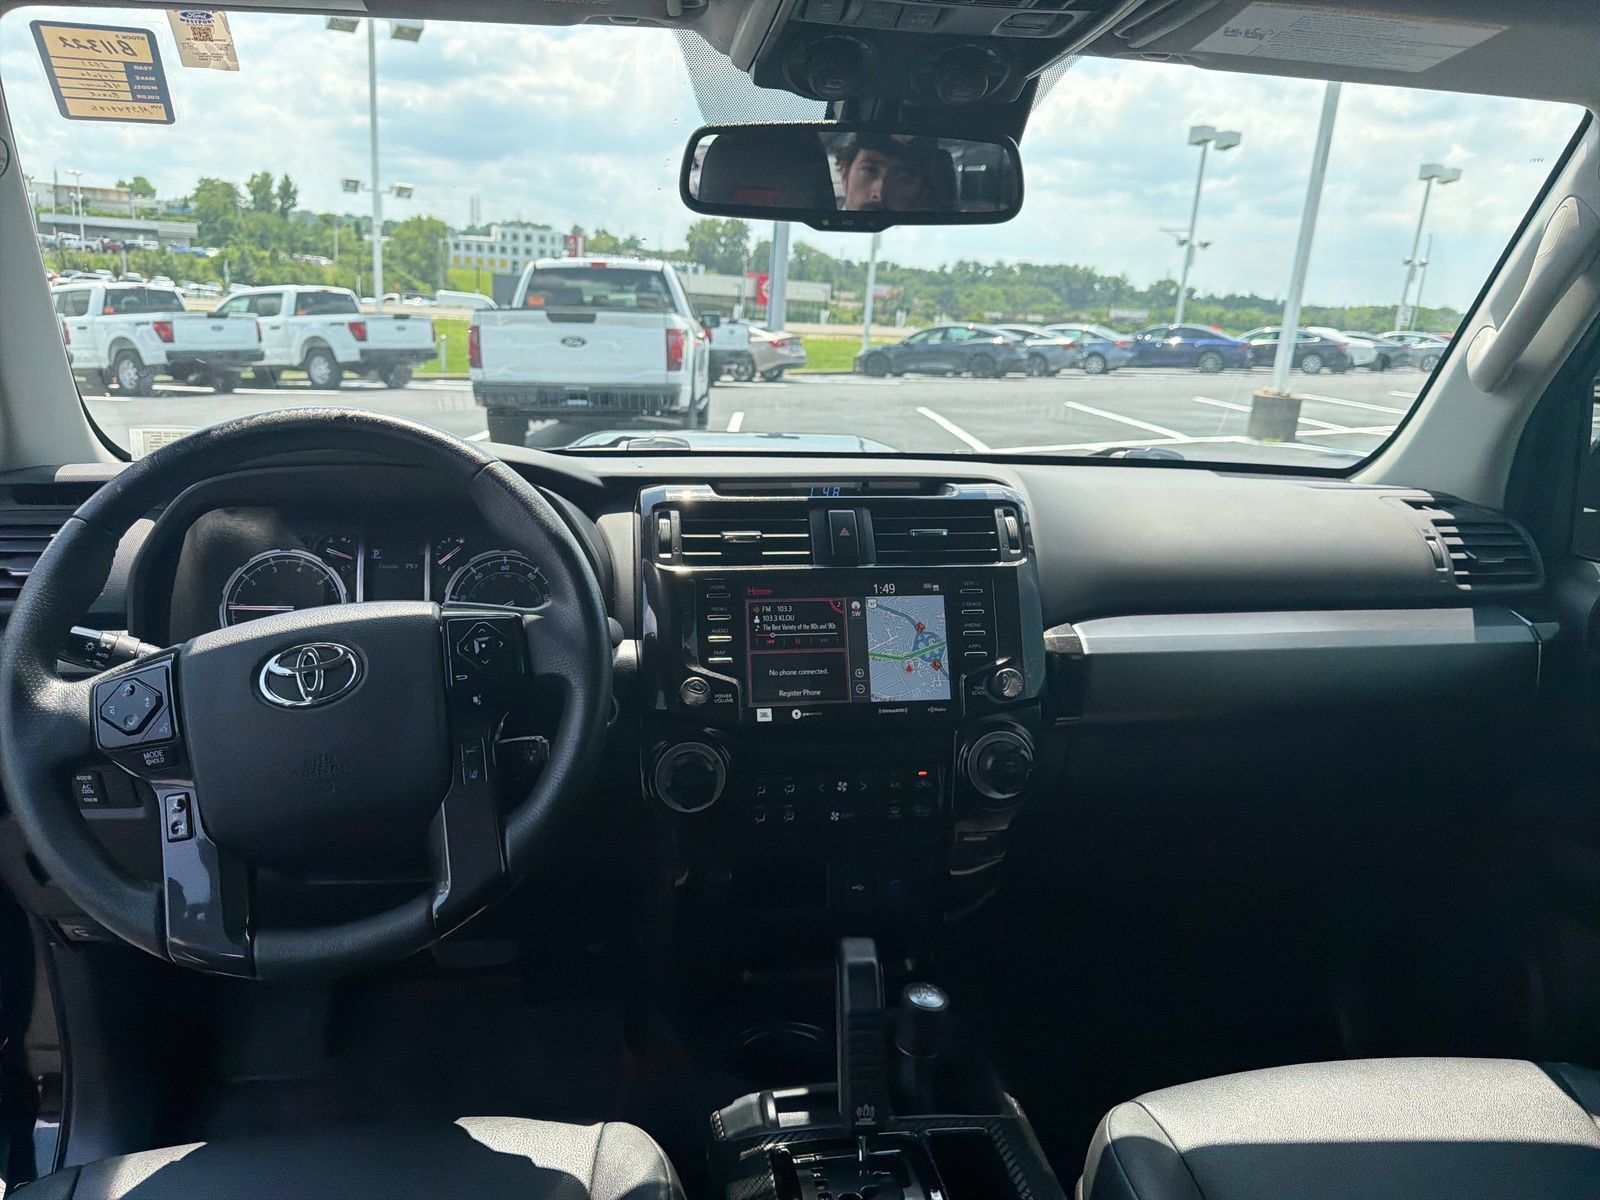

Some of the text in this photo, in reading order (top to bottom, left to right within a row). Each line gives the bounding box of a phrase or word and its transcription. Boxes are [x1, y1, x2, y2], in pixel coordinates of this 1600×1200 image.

[747, 587, 773, 596] Home
[873, 583, 896, 595] 1:49
[777, 605, 793, 613] 103.3
[782, 623, 796, 632] Variety
[768, 668, 829, 678] No phone connected.
[778, 689, 822, 698] Register Phone
[143, 749, 164, 760] MODE
